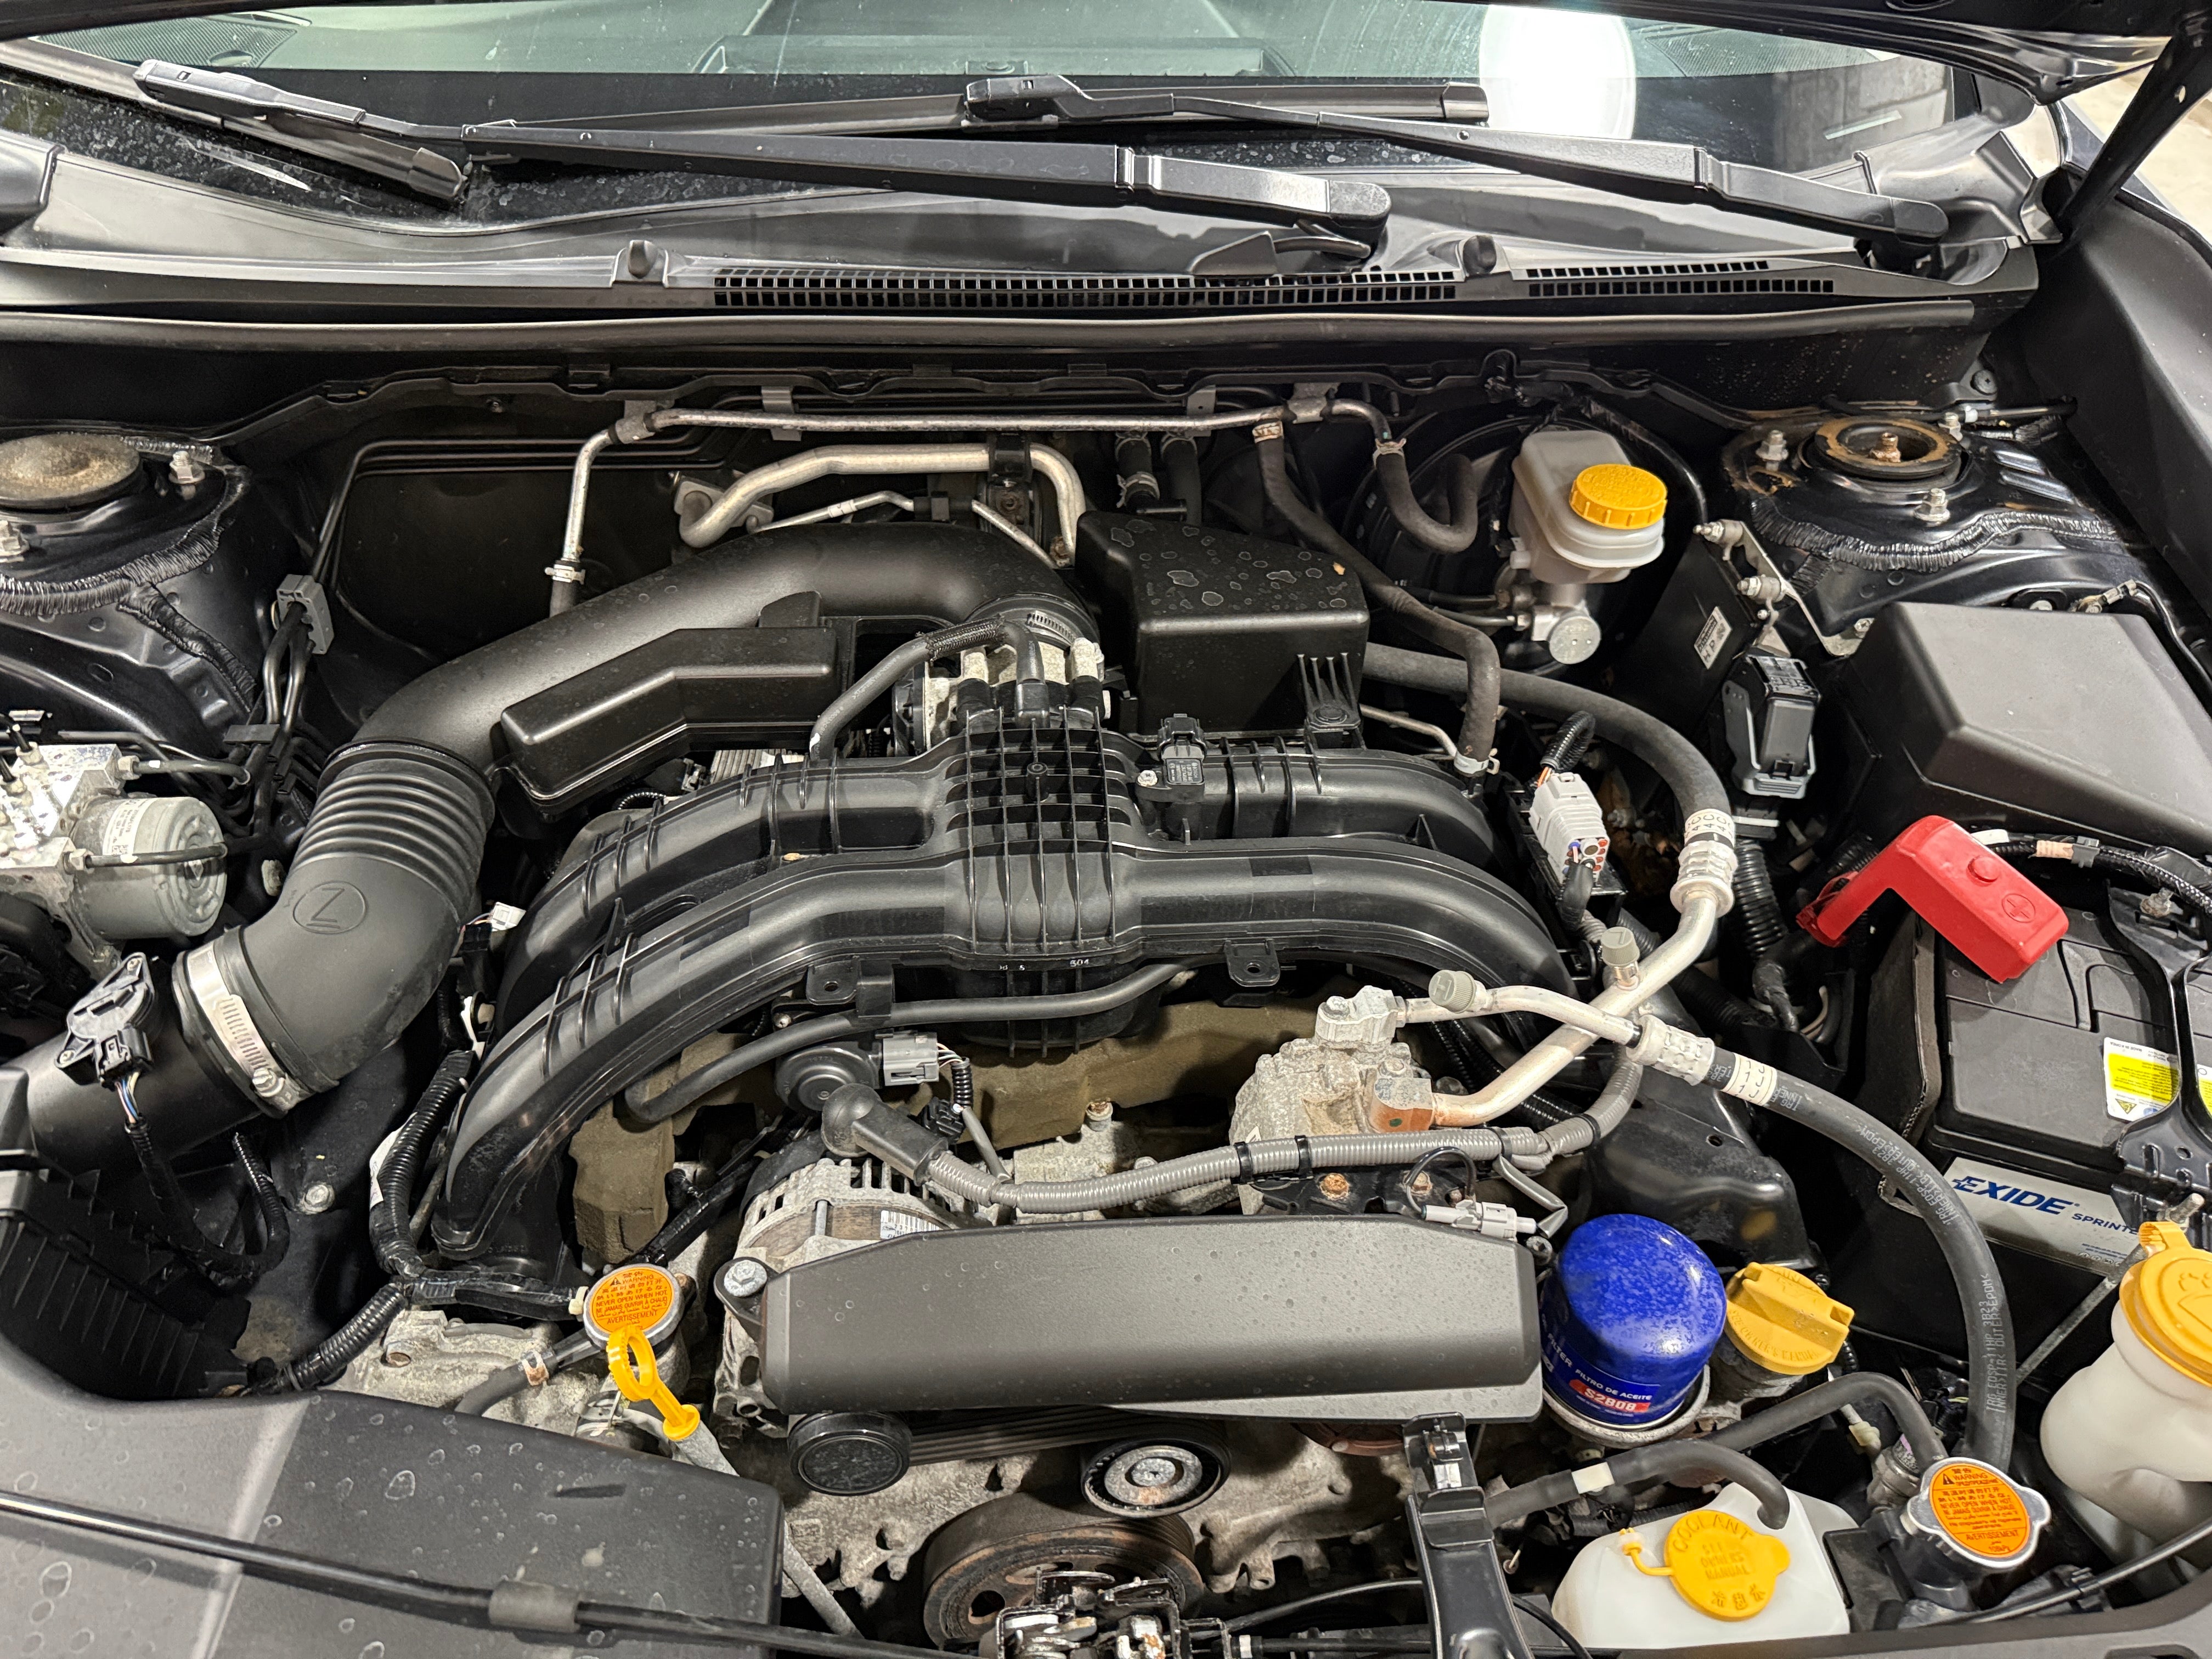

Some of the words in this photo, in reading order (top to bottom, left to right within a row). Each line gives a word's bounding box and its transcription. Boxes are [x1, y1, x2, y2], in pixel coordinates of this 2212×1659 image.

[1952, 1176, 2073, 1215] EXIDE
[2071, 1213, 2138, 1234] SPRINTE
[622, 1274, 654, 1284] WARNING
[596, 1299, 615, 1307] NEVER
[605, 1302, 623, 1312] JAMAIS
[607, 1310, 658, 1325] AVERTISSEMENT
[1575, 1369, 1604, 1390] FILTRO
[1605, 1387, 1619, 1396] DE
[1619, 1392, 1653, 1401] ACEITE
[1584, 1388, 1637, 1412] S2808
[1953, 1472, 1988, 1481] WARNING
[1673, 1514, 1753, 1553] COOLANT
[1966, 1530, 2019, 1541] AVERTISSEMENT
[1705, 1564, 1750, 1581] MANUAL
